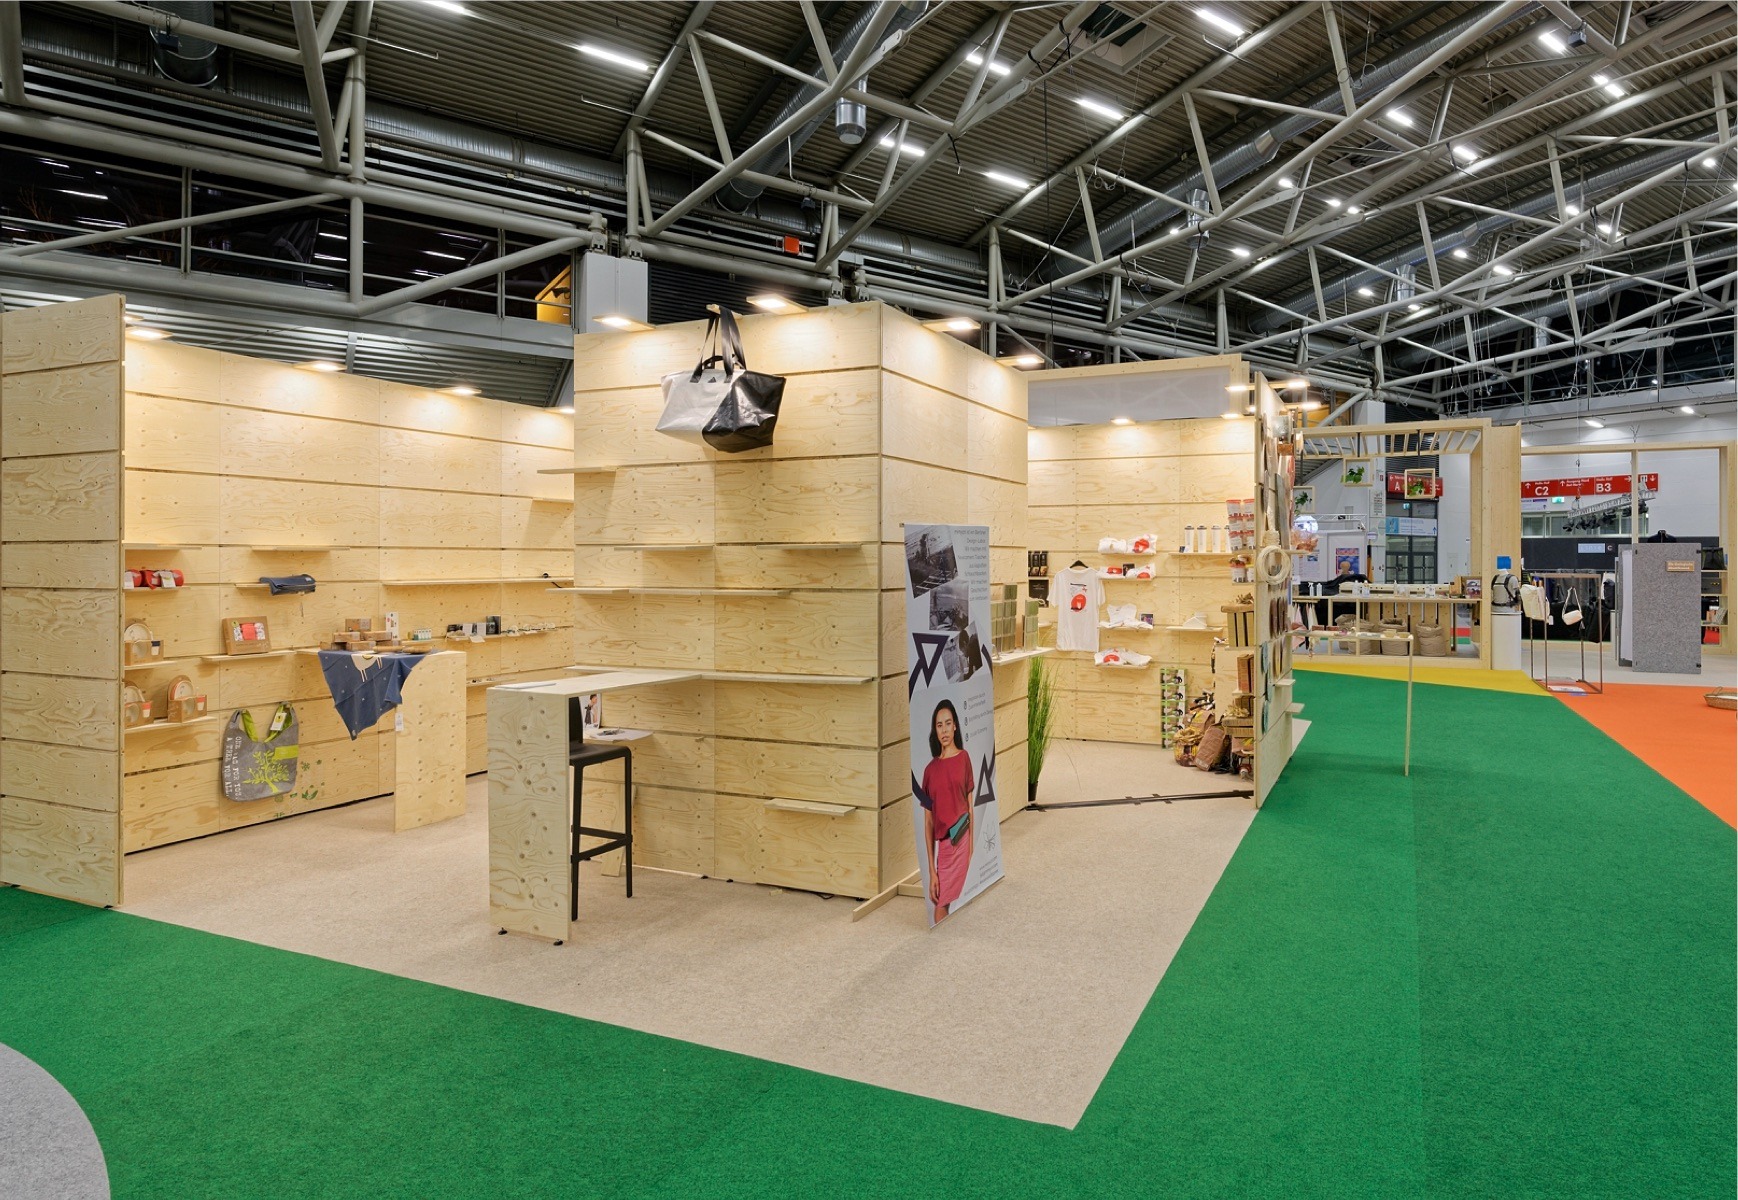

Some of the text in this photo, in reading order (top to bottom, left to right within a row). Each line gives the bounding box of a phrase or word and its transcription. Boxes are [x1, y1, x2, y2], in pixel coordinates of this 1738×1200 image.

[1394, 481, 1400, 491] A
[1535, 486, 1549, 496] C2
[1595, 483, 1612, 493] B3
